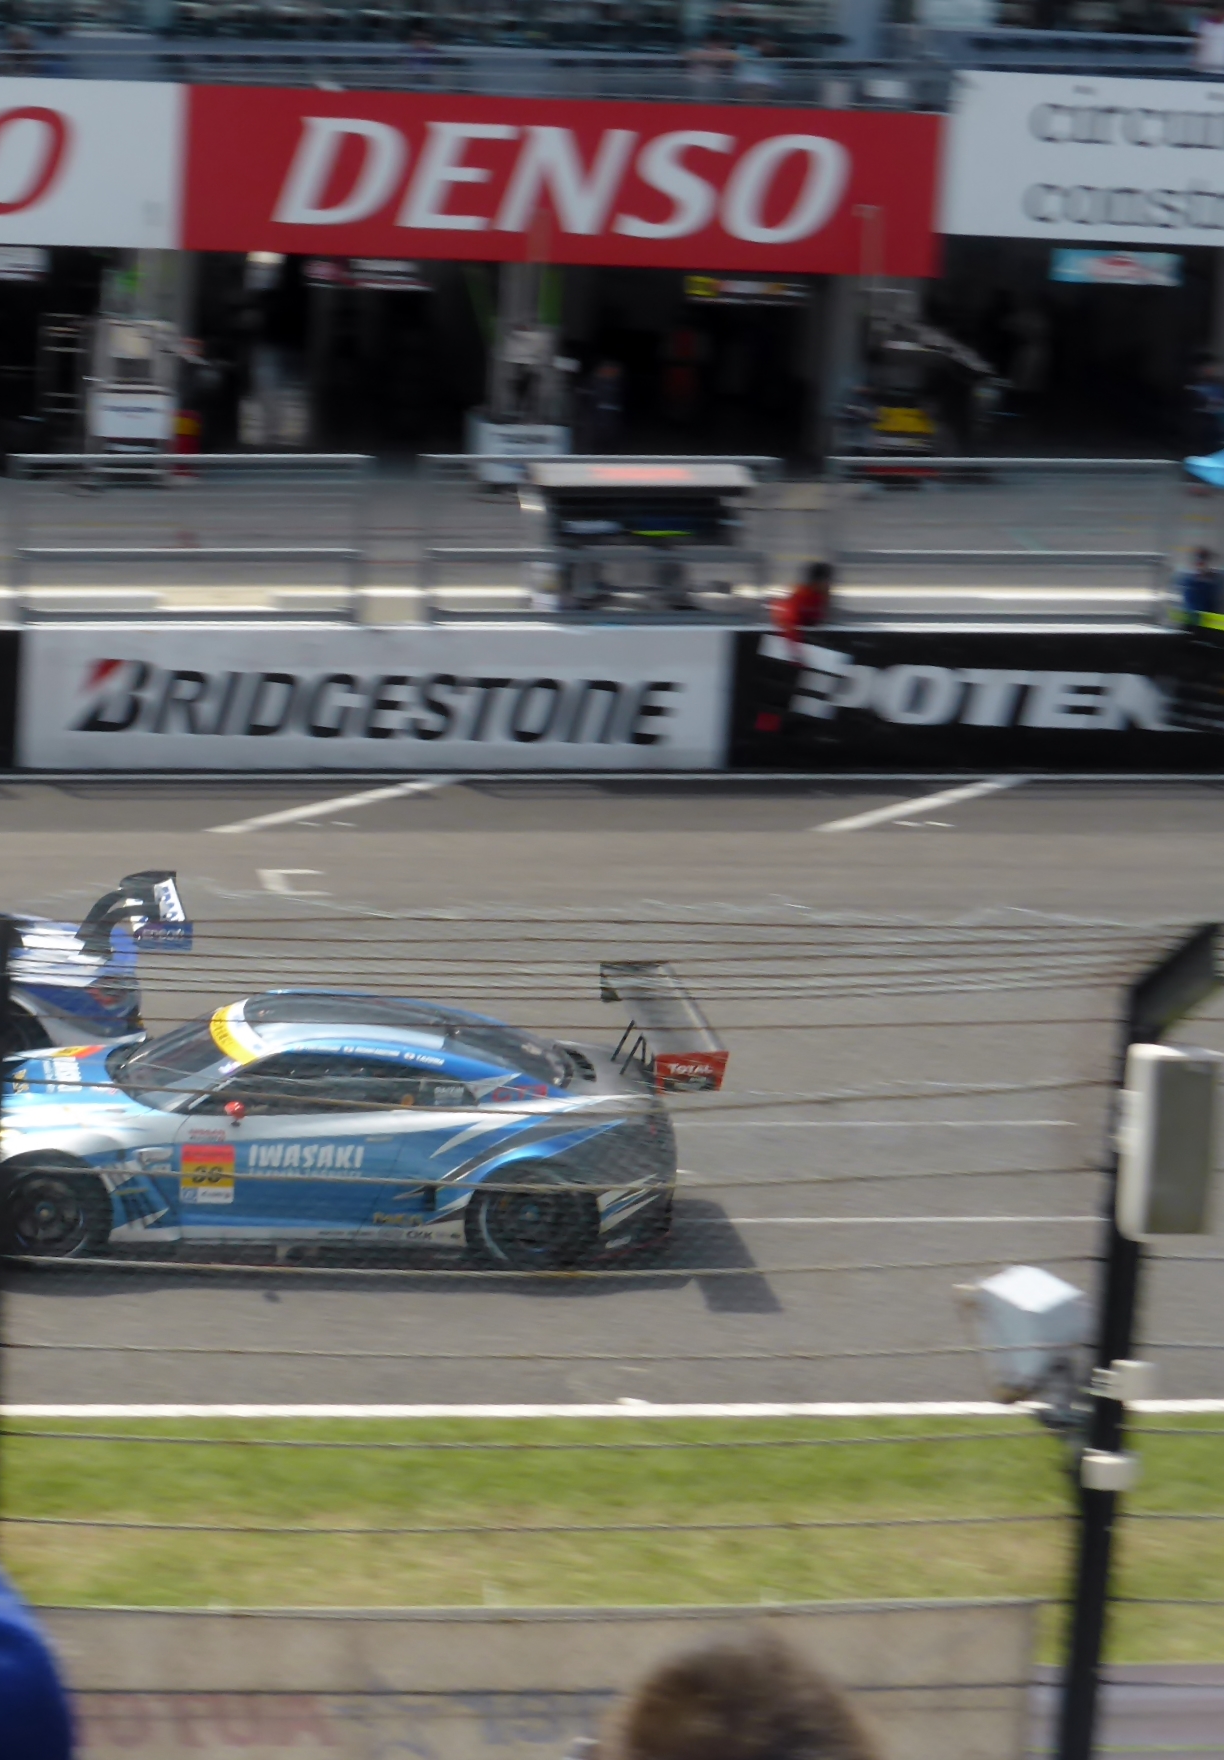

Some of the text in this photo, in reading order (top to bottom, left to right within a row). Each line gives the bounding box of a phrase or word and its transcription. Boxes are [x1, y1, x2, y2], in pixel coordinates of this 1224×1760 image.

[272, 116, 853, 245] DENSO
[72, 658, 682, 745] BRIDGESTONE
[248, 1144, 365, 1169] IWASAKI
